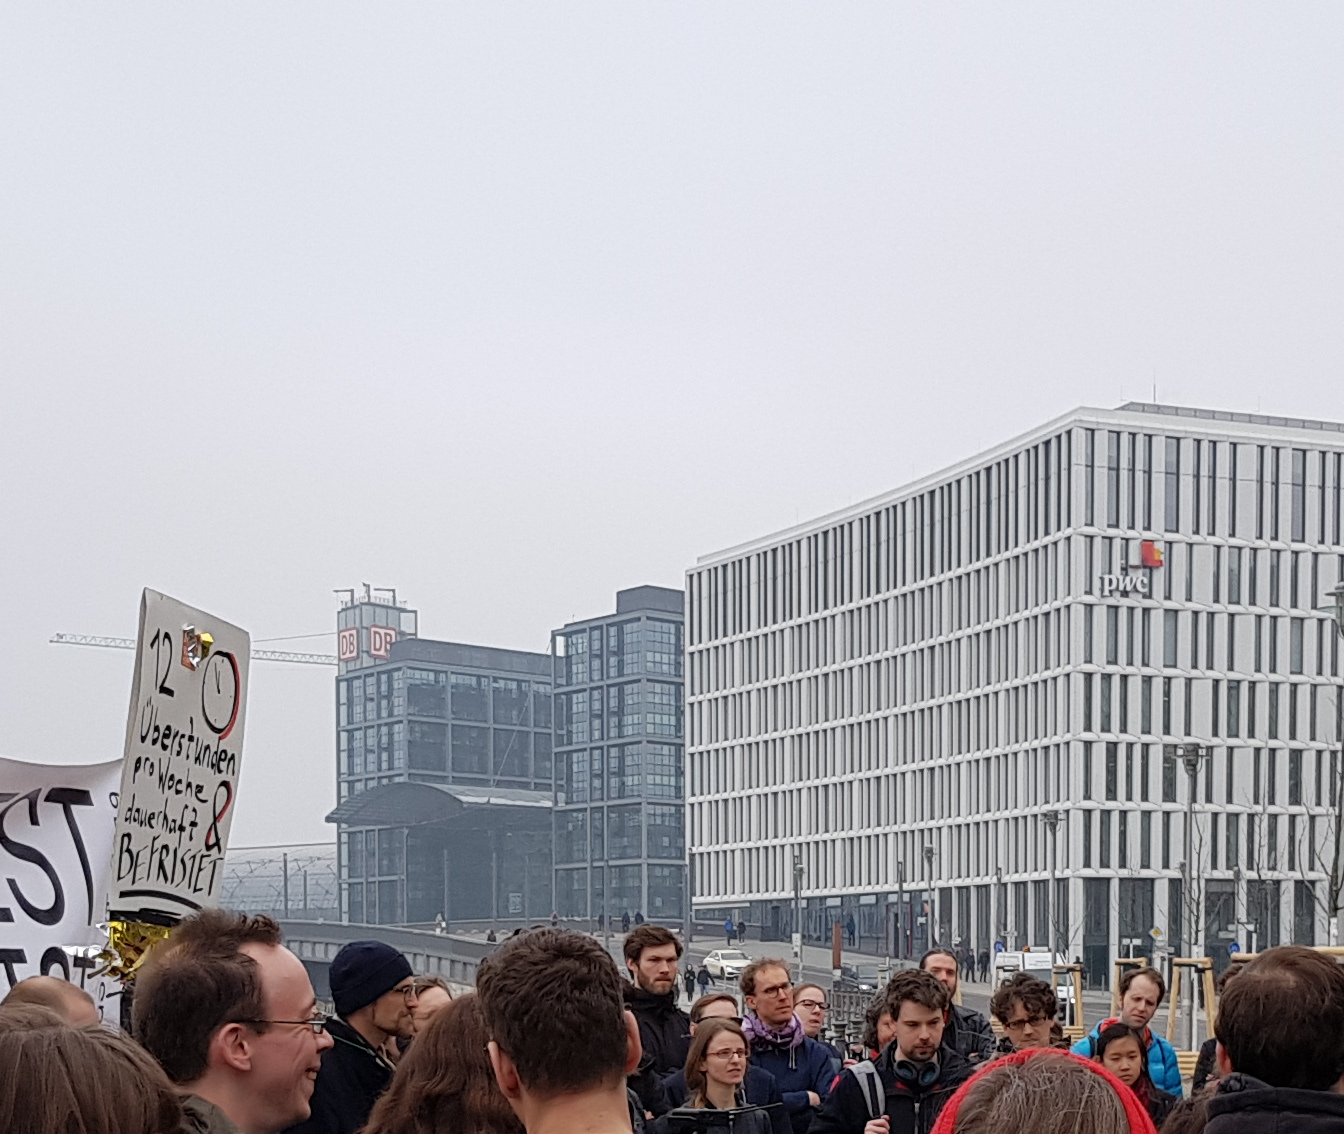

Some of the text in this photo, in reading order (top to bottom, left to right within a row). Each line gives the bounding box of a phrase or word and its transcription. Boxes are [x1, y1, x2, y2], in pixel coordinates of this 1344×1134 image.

[1102, 574, 1149, 597] pwc
[150, 627, 175, 698] 12
[341, 632, 355, 656] DB
[139, 698, 237, 776] Überstunden
[133, 757, 208, 803] pro Woche
[125, 793, 198, 848] dauerhaft
[117, 831, 225, 897] BEFRISTET
